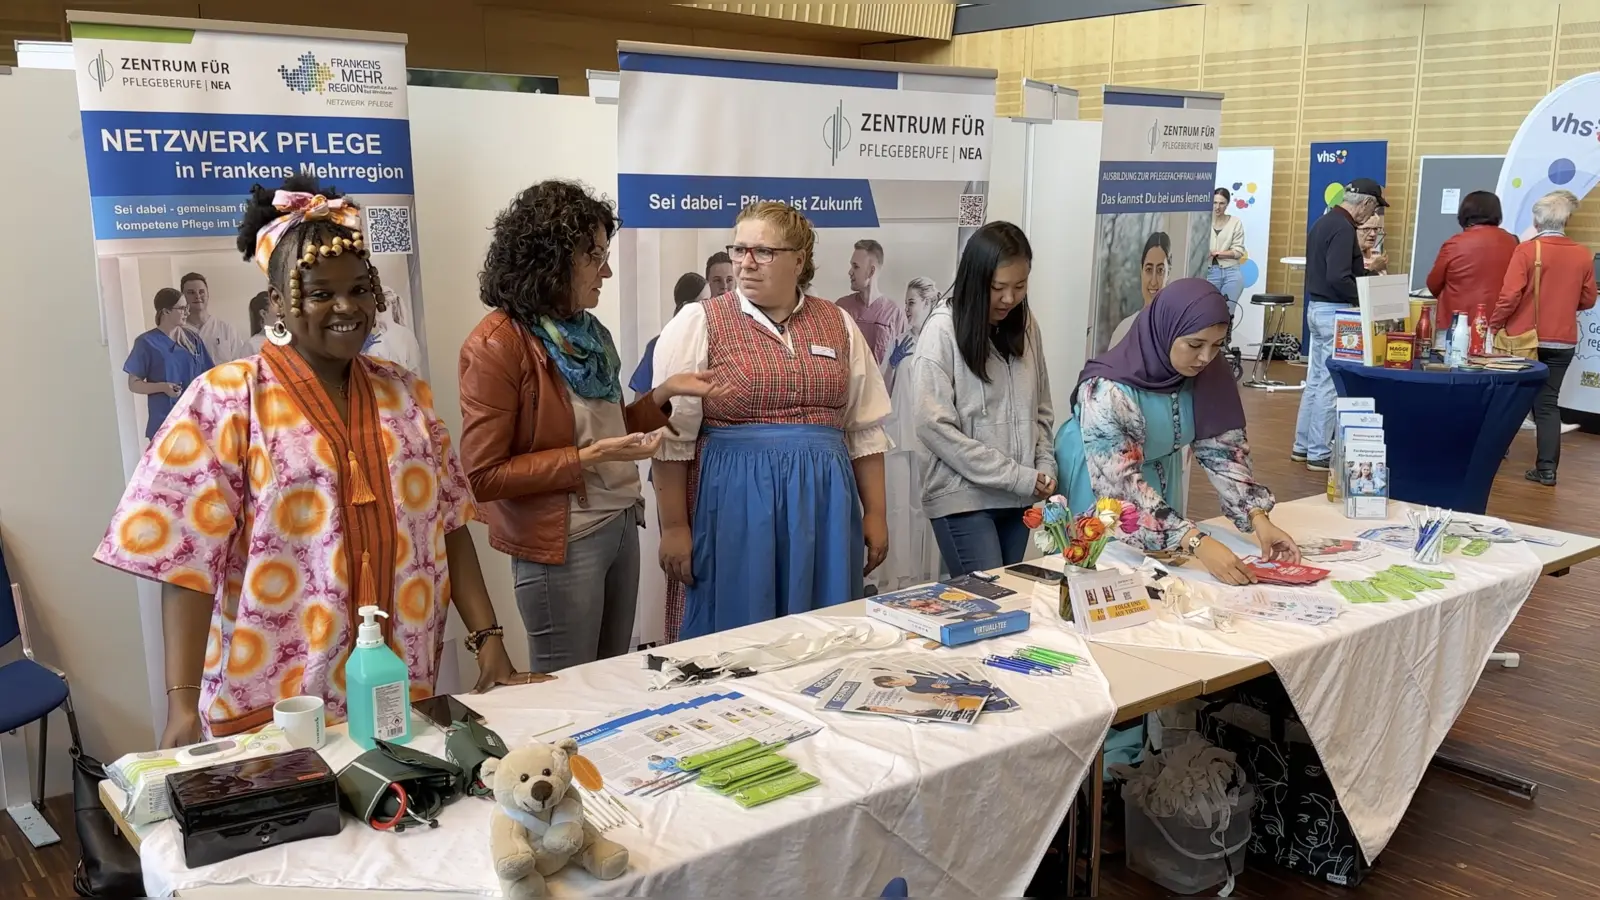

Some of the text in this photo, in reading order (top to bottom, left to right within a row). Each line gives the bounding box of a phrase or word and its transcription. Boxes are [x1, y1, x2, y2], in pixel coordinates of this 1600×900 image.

[121, 58, 230, 74] ZENTRUM FÜR
[331, 58, 381, 69] FRANKENS
[122, 77, 232, 90] PFLEGEBERUFE NEA
[341, 69, 383, 84] MEHR
[328, 83, 363, 93] REGION
[861, 113, 985, 136] ZENTRUM FÜR
[1163, 125, 1215, 137] ZENTRUM FÜR
[1552, 112, 1594, 137] vhs
[101, 129, 382, 155] NETZWERK PFLEGE
[1162, 141, 1199, 150] PFLEGEBERUFE
[859, 143, 983, 160] PFLEGEBERUFE NEA
[1317, 150, 1336, 163] vhs
[175, 161, 404, 182] in Frankens Mehrregion
[649, 193, 675, 210] Sei
[681, 195, 723, 210] dabei
[790, 195, 807, 211] ist
[810, 196, 863, 211] Zukunft
[1101, 191, 1211, 205] Das kannst Du bei uns lernen!
[114, 205, 132, 214] Sei
[136, 204, 167, 214] dabei
[177, 204, 236, 215] gemeinsam
[116, 221, 179, 232] kompetene
[182, 219, 214, 230] Pflege
[217, 219, 229, 228] im
